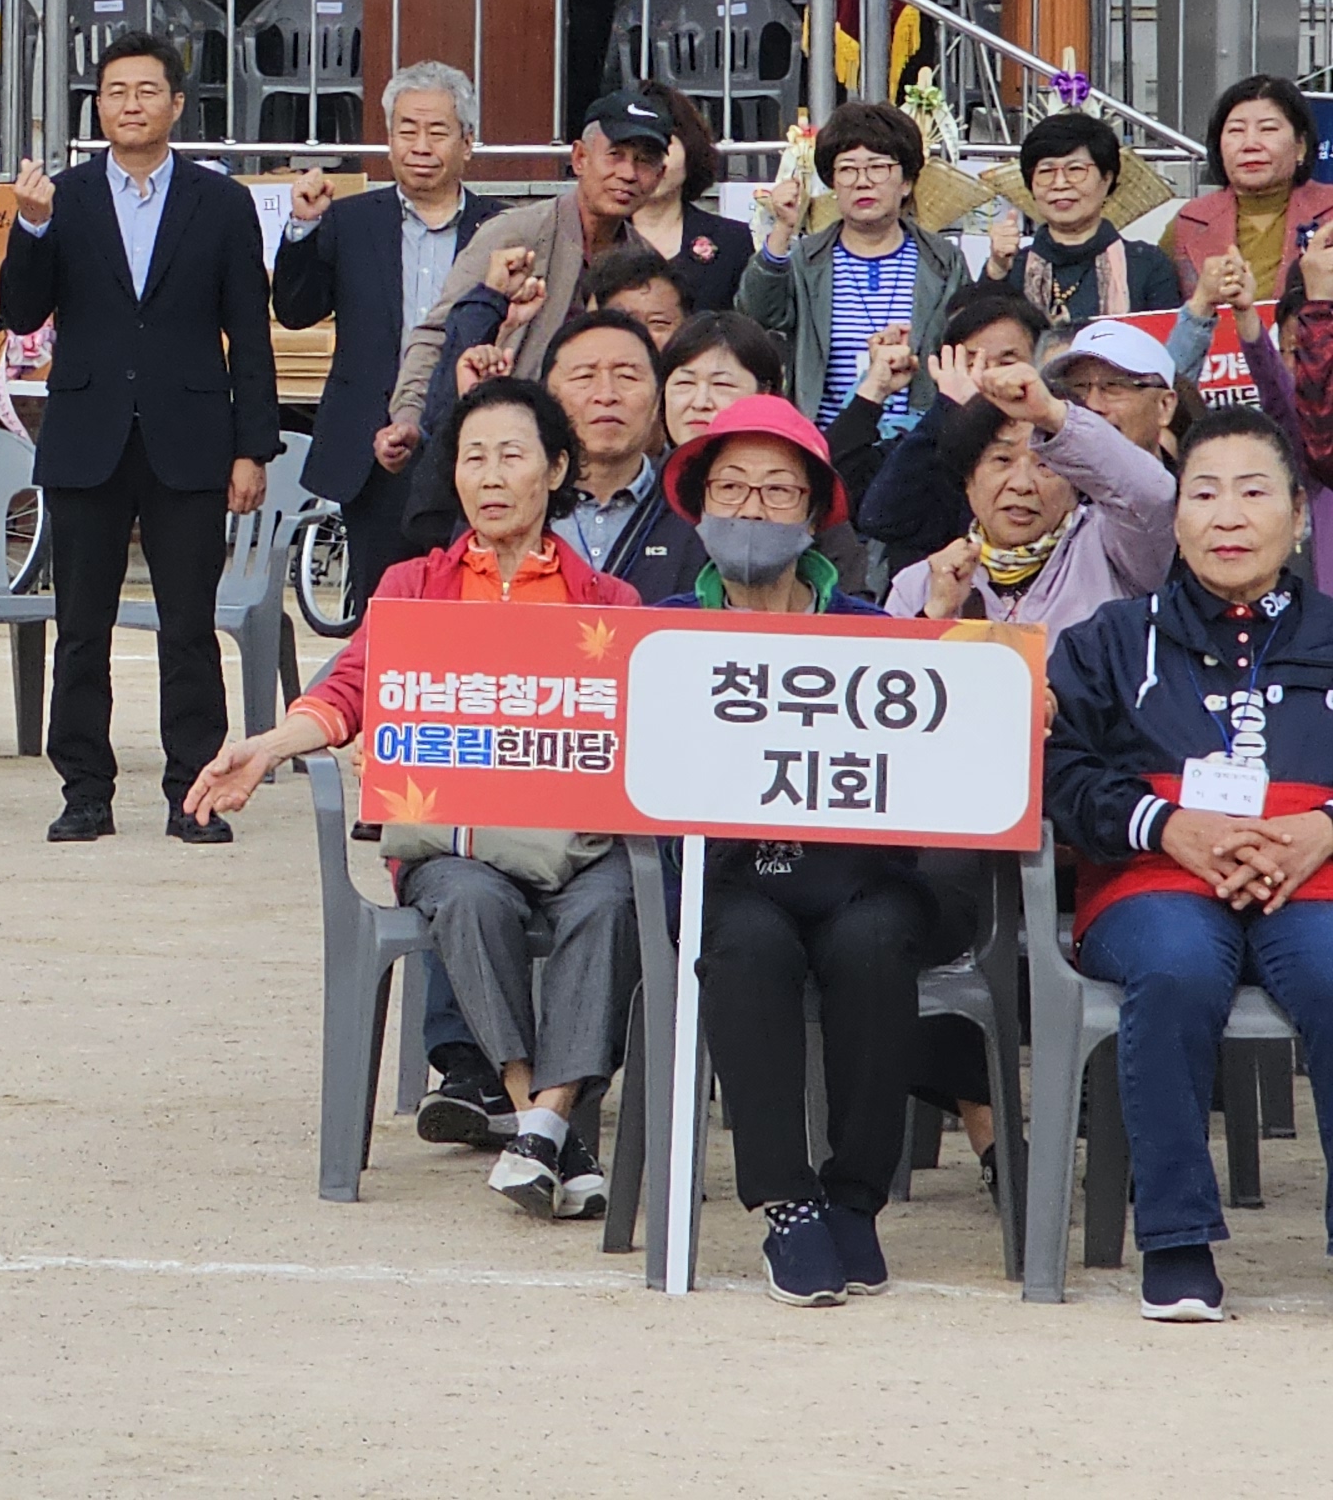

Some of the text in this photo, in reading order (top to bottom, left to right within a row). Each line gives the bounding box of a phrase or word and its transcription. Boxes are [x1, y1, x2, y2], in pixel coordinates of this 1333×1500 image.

[645, 545, 668, 556] K2
[379, 669, 618, 720] 하남충청가족
[710, 658, 948, 733] 청우(8)
[374, 721, 619, 775] 어울림한마당
[760, 748, 889, 815] 지회
